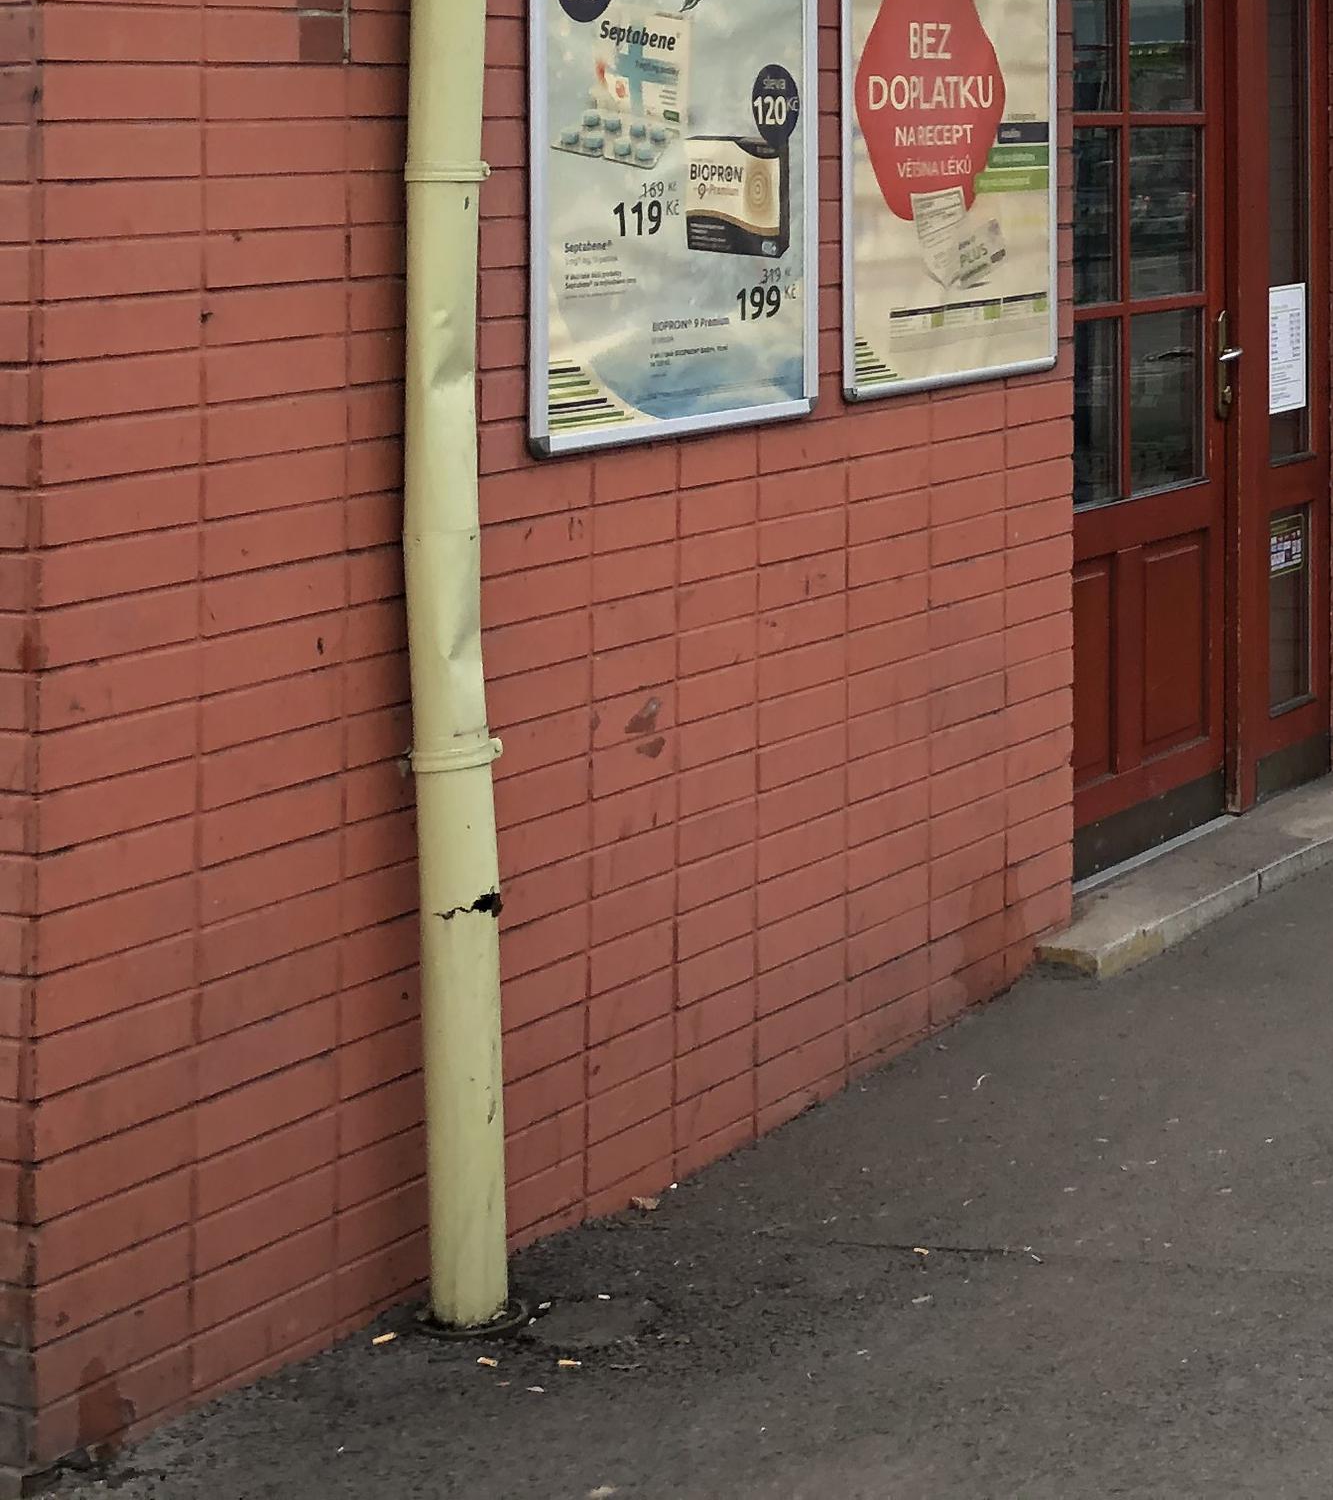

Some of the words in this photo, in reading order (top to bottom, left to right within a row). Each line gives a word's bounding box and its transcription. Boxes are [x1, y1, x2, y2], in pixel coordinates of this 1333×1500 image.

[910, 22, 951, 60] BEZ
[762, 75, 786, 90] sleva
[868, 75, 993, 110] DOPLATKU
[753, 95, 787, 126] 120
[895, 126, 918, 147] NA
[917, 124, 974, 146] RECEPT
[940, 153, 972, 176] LÉKŮ
[639, 181, 664, 199] 169
[612, 200, 662, 237] 119
[665, 199, 680, 216] Kč
[736, 285, 781, 321] 199
[784, 283, 797, 300] Kč
